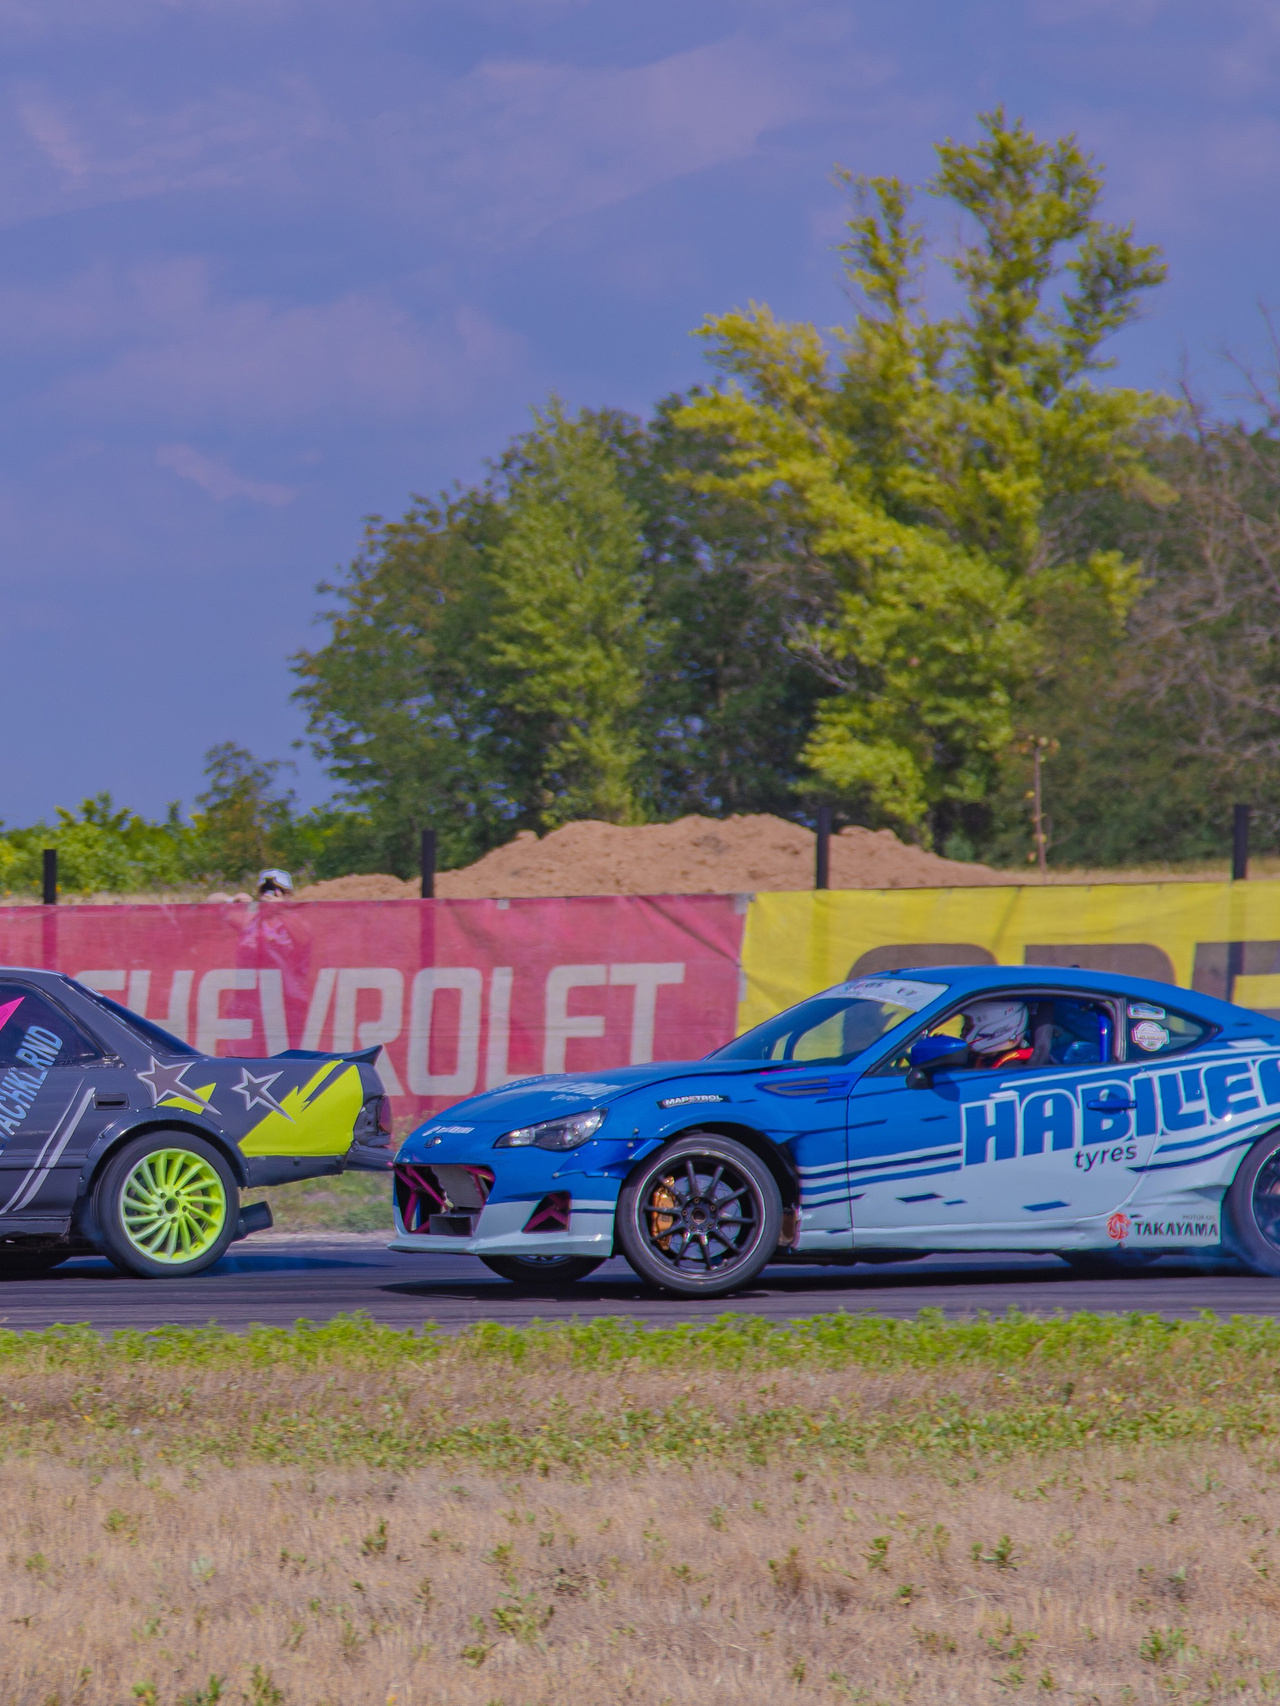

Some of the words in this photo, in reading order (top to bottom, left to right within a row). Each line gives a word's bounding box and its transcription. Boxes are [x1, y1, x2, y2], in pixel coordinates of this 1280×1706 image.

[665, 1094, 723, 1106] MAPETROL
[1075, 1144, 1137, 1173] tyres
[1135, 1222, 1219, 1236] TAKAYAMA
